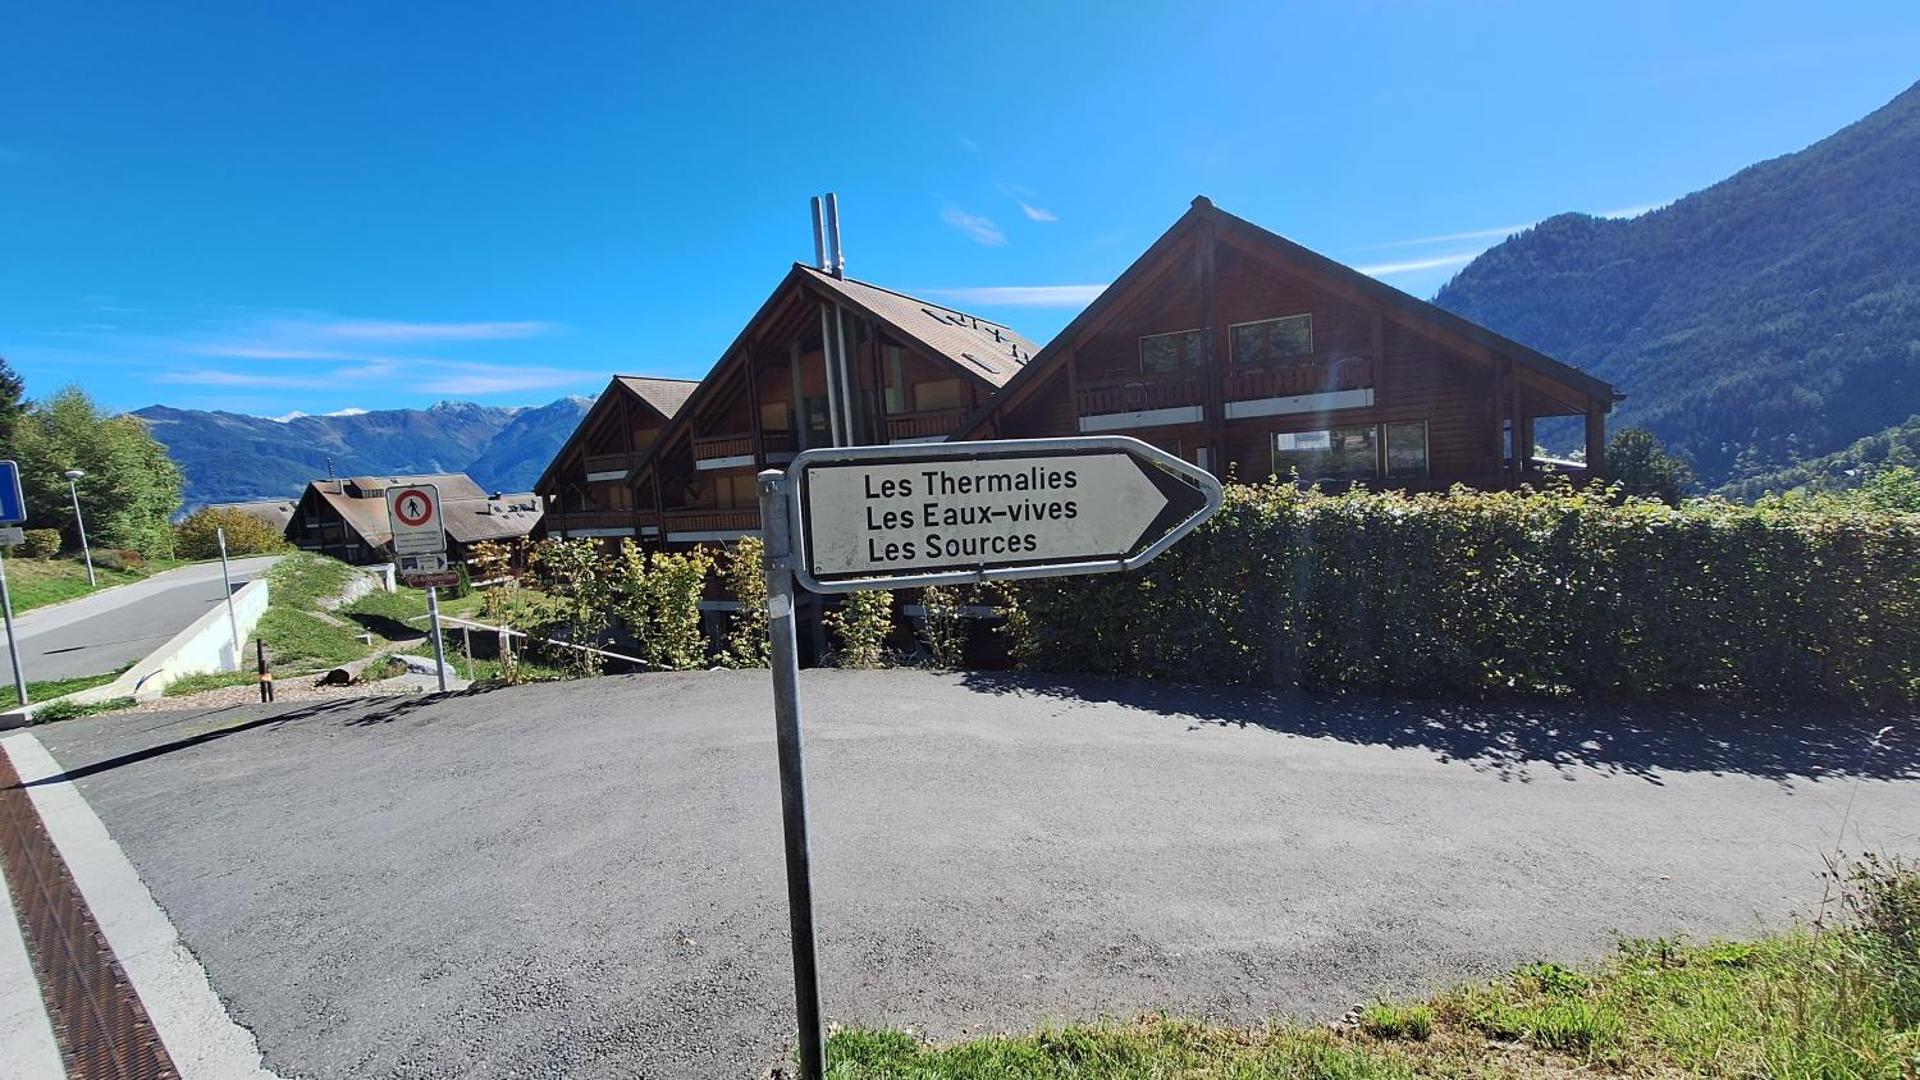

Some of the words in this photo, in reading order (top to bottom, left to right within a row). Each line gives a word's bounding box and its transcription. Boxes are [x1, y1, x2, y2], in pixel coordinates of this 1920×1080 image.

[865, 475, 913, 499] Les
[922, 467, 1077, 495] Thermalies
[867, 507, 915, 530] Les
[924, 499, 1078, 528] Eaux-vives
[869, 538, 916, 562] Les
[926, 534, 1037, 558] Sources
